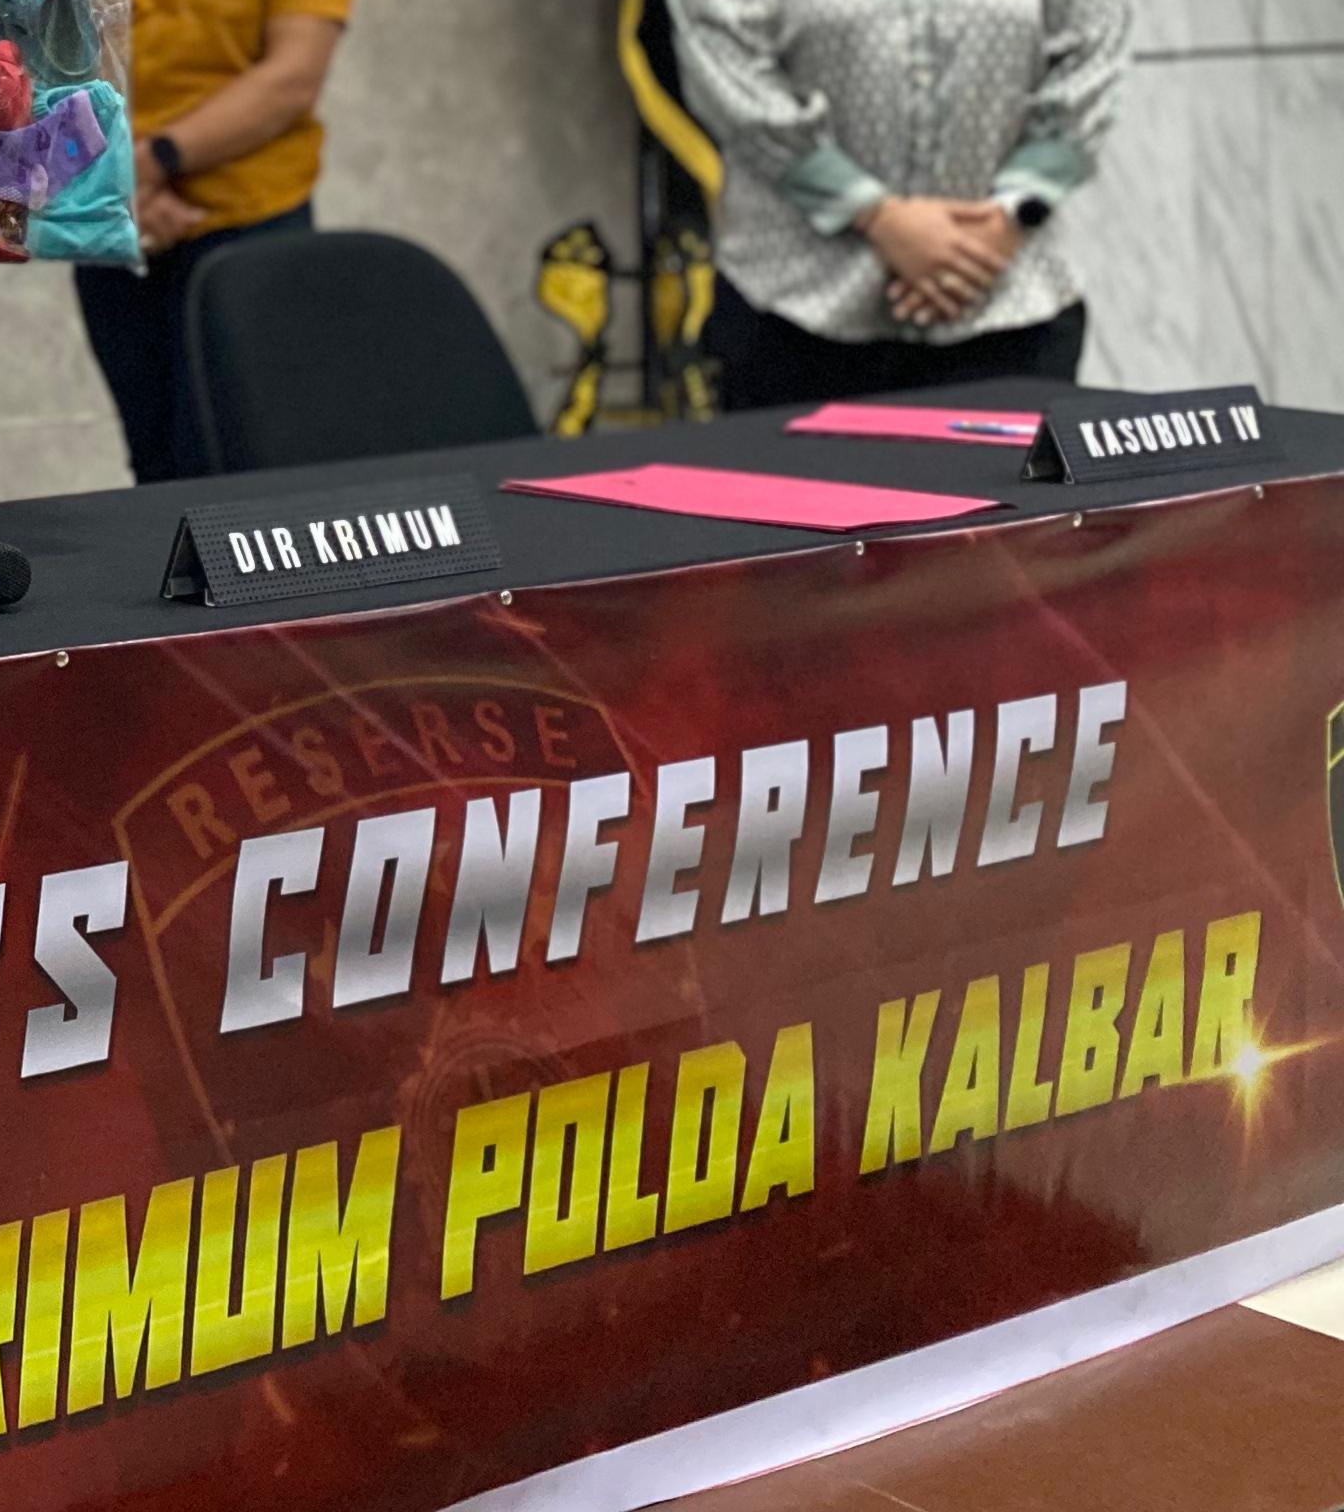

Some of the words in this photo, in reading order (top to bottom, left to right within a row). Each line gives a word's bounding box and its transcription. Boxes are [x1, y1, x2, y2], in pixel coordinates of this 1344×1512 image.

[1079, 410, 1222, 458] KASUBDIT
[1229, 405, 1261, 441] IV
[229, 528, 302, 574] DIR
[308, 504, 461, 565] KRIMUM
[165, 698, 579, 860] RESERSE
[219, 680, 1127, 1033] CONFERENCE
[441, 1022, 814, 1301] POLDA
[859, 910, 1261, 1176] KALBAR
